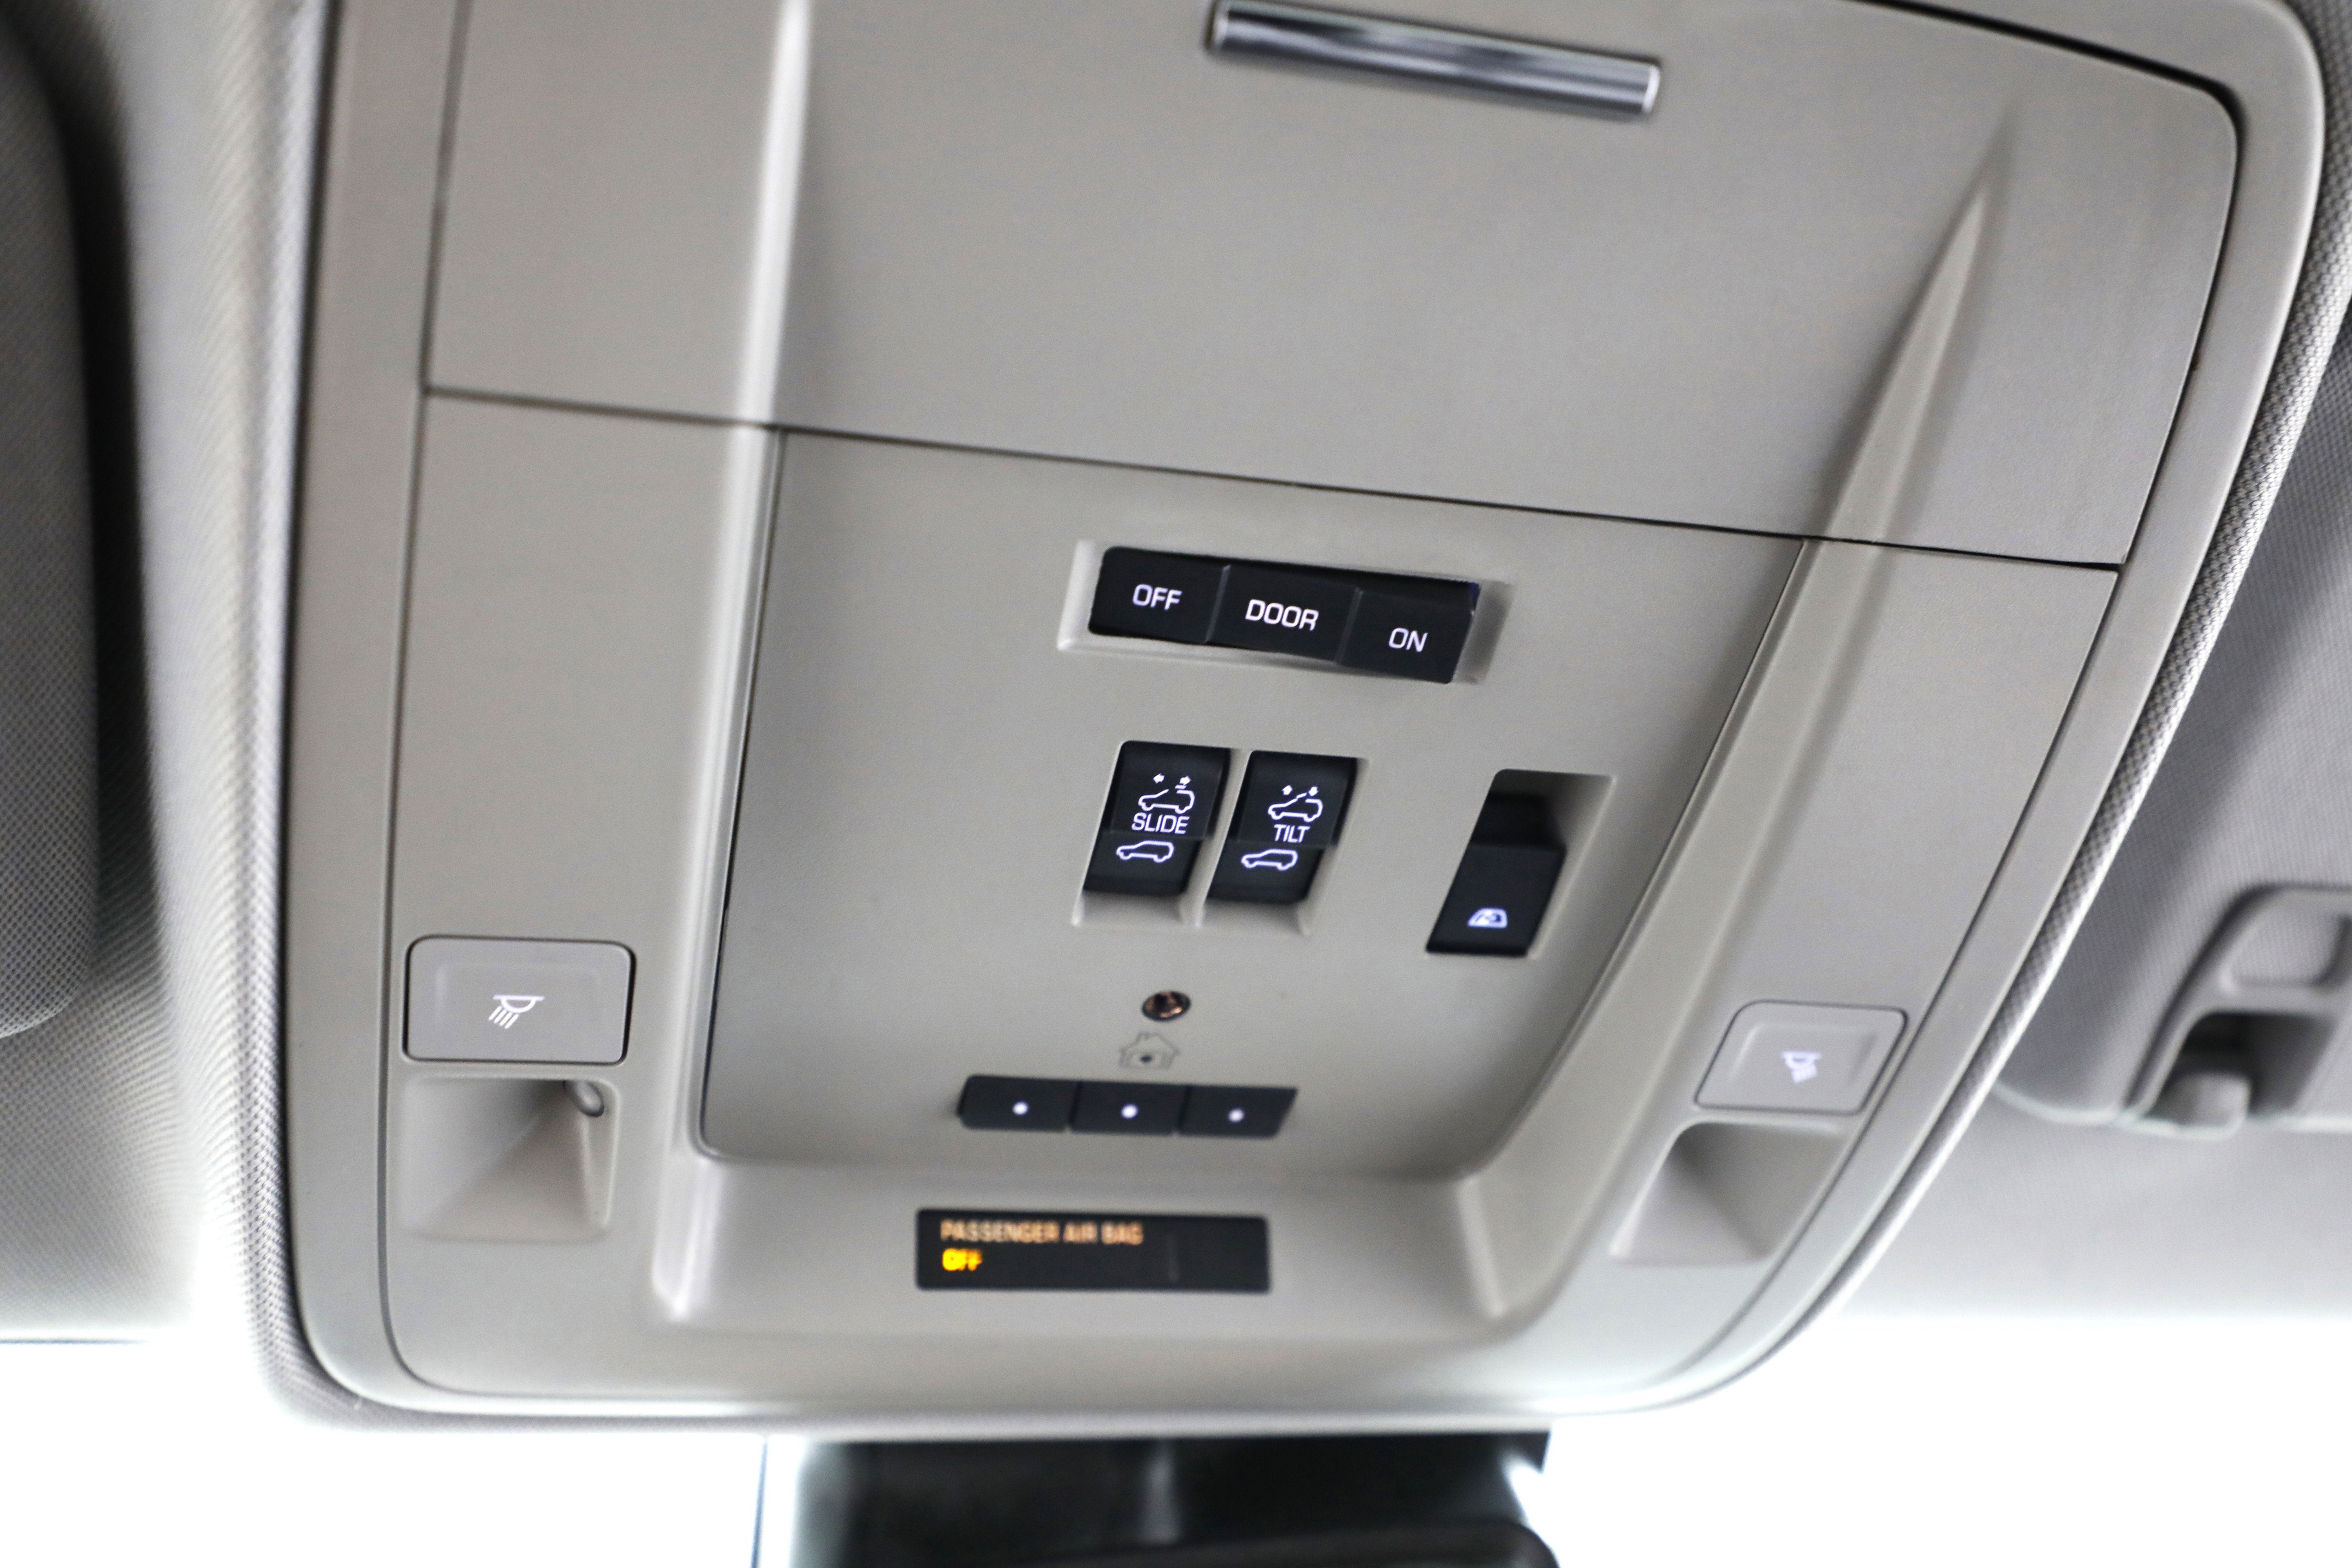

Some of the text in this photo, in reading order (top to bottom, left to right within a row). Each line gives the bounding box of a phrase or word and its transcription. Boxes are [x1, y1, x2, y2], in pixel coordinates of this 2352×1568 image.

[1133, 584, 1182, 610] OFF
[1245, 599, 1319, 632] DOOR
[1388, 627, 1428, 653] ON
[1131, 812, 1189, 835] SLIDE
[1274, 824, 1310, 843] TILT
[941, 1220, 1143, 1245] PASSENGER AIR BAG
[942, 1248, 982, 1271] OFF
